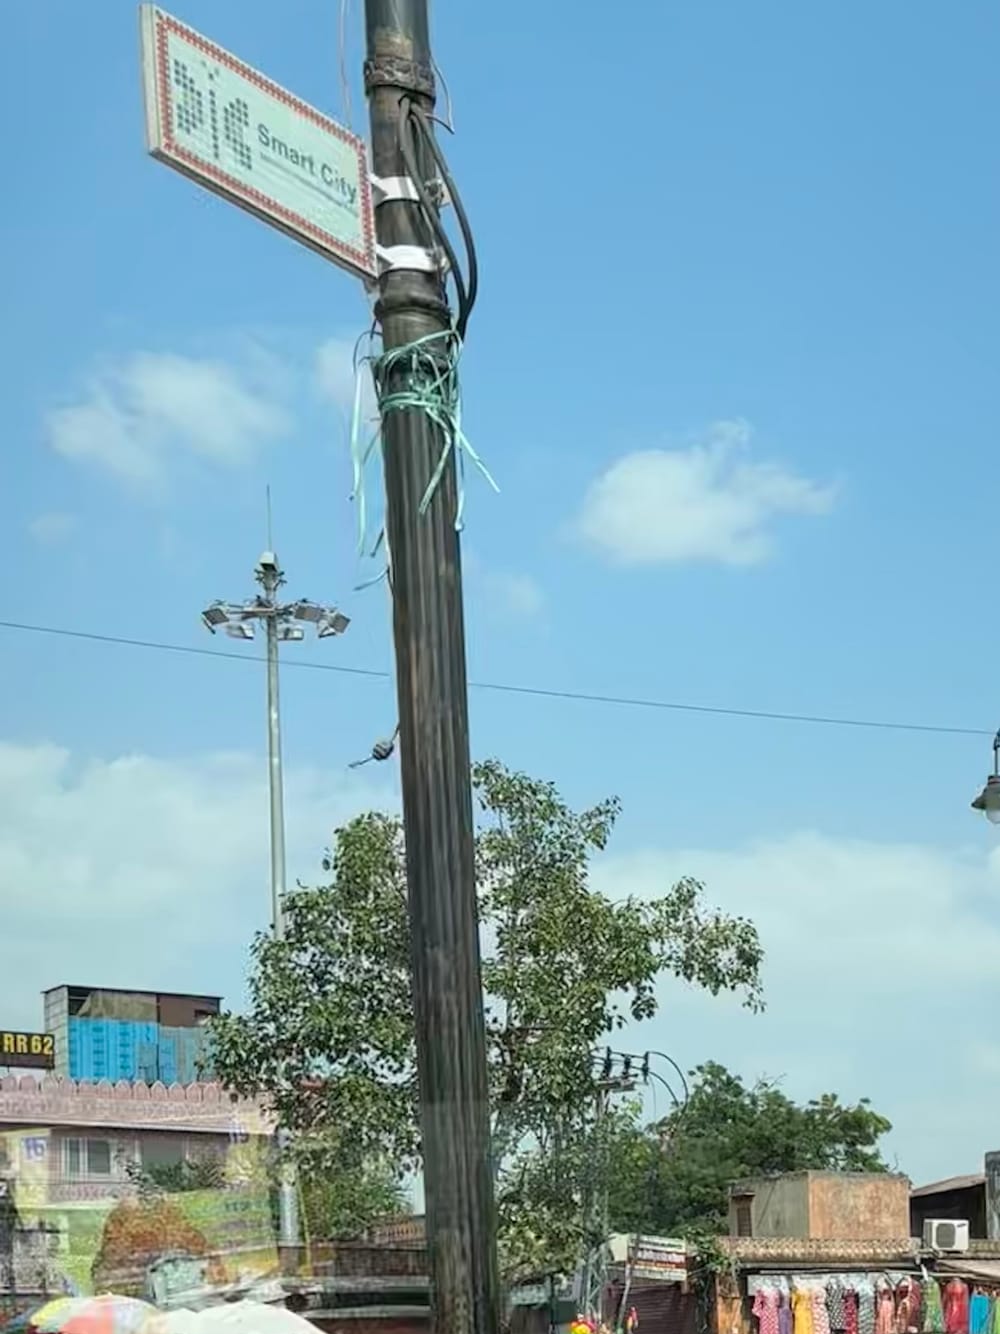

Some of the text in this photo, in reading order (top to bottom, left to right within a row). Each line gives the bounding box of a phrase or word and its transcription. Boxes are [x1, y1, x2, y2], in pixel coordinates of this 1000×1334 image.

[257, 123, 316, 177] Smart
[320, 162, 357, 205] City
[31, 1035, 53, 1055] 62
